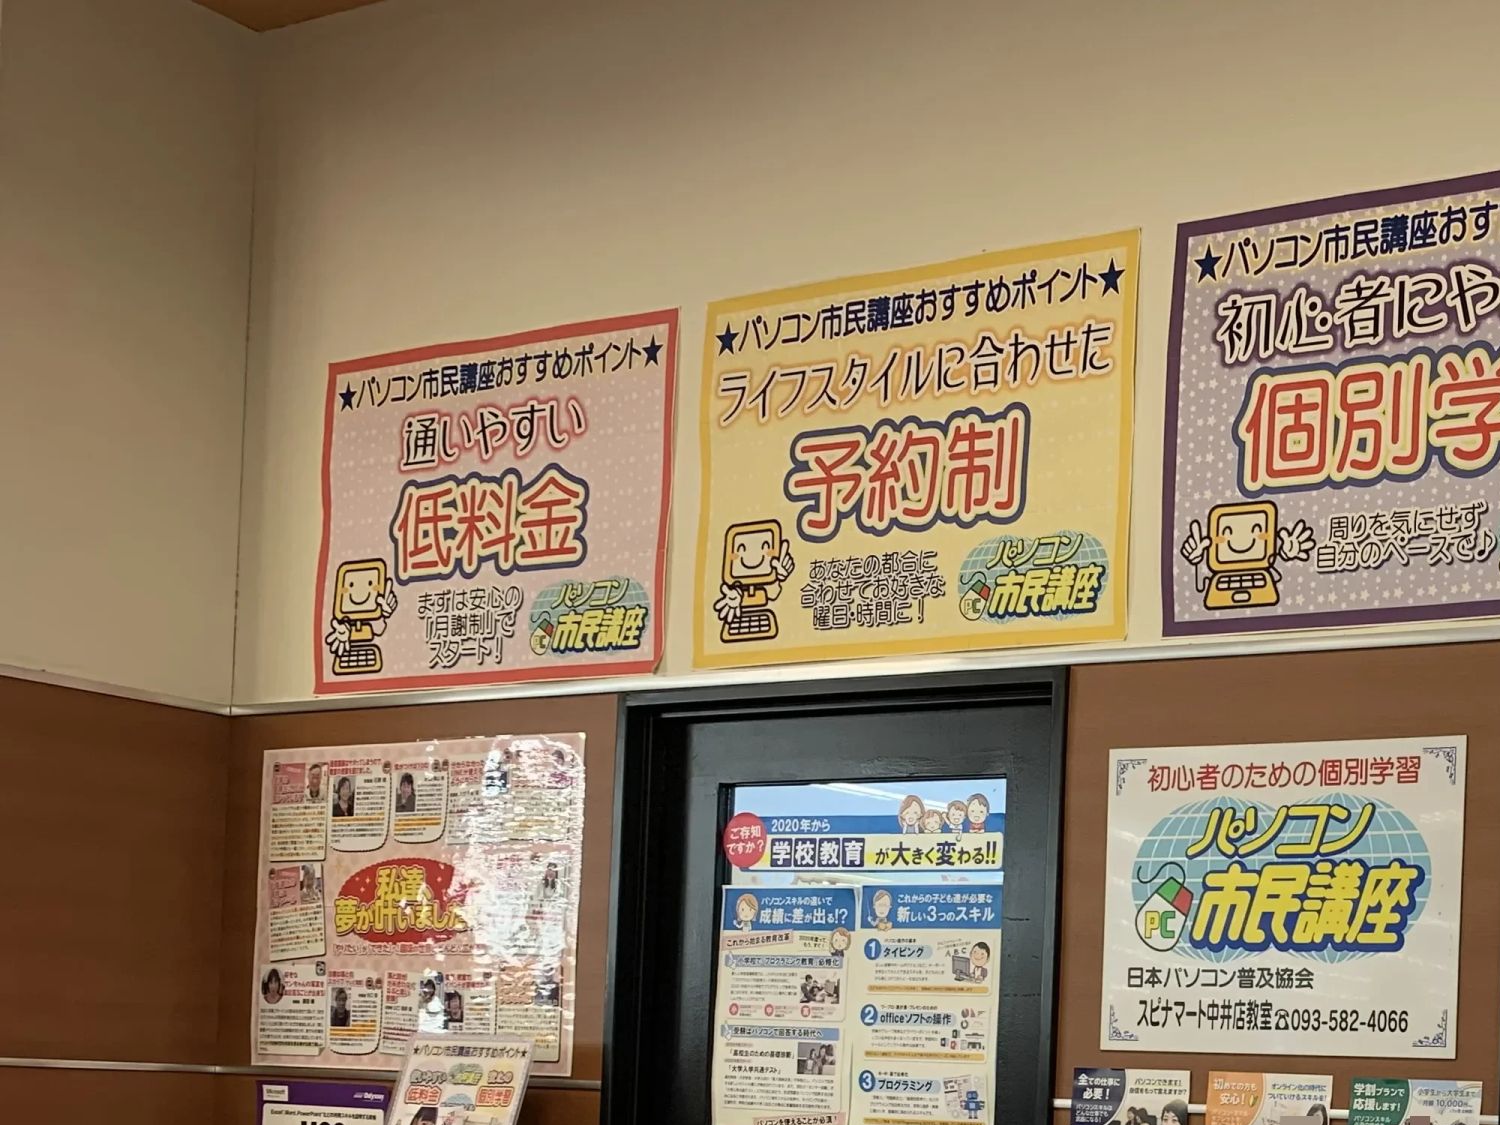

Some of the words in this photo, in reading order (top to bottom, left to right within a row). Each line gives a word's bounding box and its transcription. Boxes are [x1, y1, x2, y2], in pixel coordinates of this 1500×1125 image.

[739, 262, 1099, 351] パソコン市民講座おすすめポイント
[358, 338, 641, 408] パソコン市民講座おすすめポイント
[719, 324, 1110, 422] ライフスタイルに合わせた
[403, 400, 583, 466] 通いやすい
[790, 410, 1024, 535] 予約制
[396, 471, 583, 576] 低料金
[1328, 502, 1485, 542] 周りを気にせず
[809, 550, 938, 579] あなたの都合に
[986, 534, 1083, 570] パソコン
[417, 586, 523, 615] まずは安心の
[551, 578, 630, 609] パソコン
[800, 575, 944, 605] 合わせてお好きな
[989, 564, 1103, 616] 市民講座
[552, 605, 648, 650] 市民講座
[1147, 756, 1422, 792] 初心者のための個別学習
[730, 825, 761, 840] ご存知
[771, 819, 831, 832] 2020年から
[1186, 803, 1376, 859] パソコン
[771, 839, 865, 866] 学校教育
[761, 896, 832, 906] パソコンスキルの違いで
[897, 906, 995, 922] 新しい3つのスキル
[1189, 859, 1425, 952] 市民講座
[759, 908, 848, 924] 成績に差が出る!?
[1144, 910, 1175, 939] PC
[883, 946, 924, 958] タイピング
[1127, 967, 1315, 990] 日本パソコン普及協会
[880, 1013, 951, 1025] officeソフトの操作
[1291, 1009, 1408, 1033] 093-582-4066
[878, 1079, 933, 1092] プログラミング
[1077, 1074, 1120, 1086] 全ての仕事に
[1354, 1084, 1405, 1097] 学割プランで
